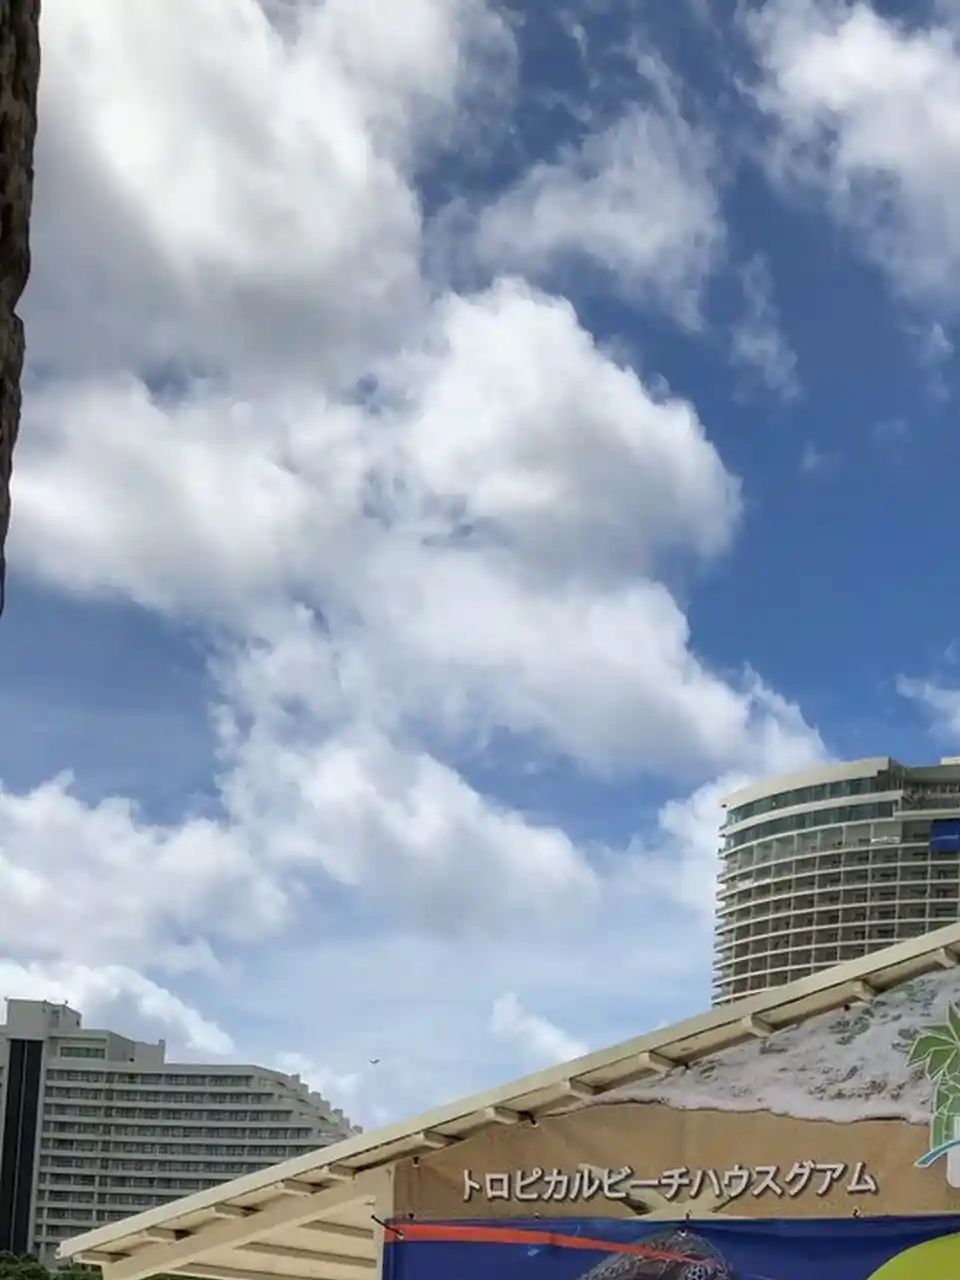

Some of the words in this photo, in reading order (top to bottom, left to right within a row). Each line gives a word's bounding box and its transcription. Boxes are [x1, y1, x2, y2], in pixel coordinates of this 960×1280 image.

[462, 1160, 879, 1201] トロピカルビーチハウスグアム
